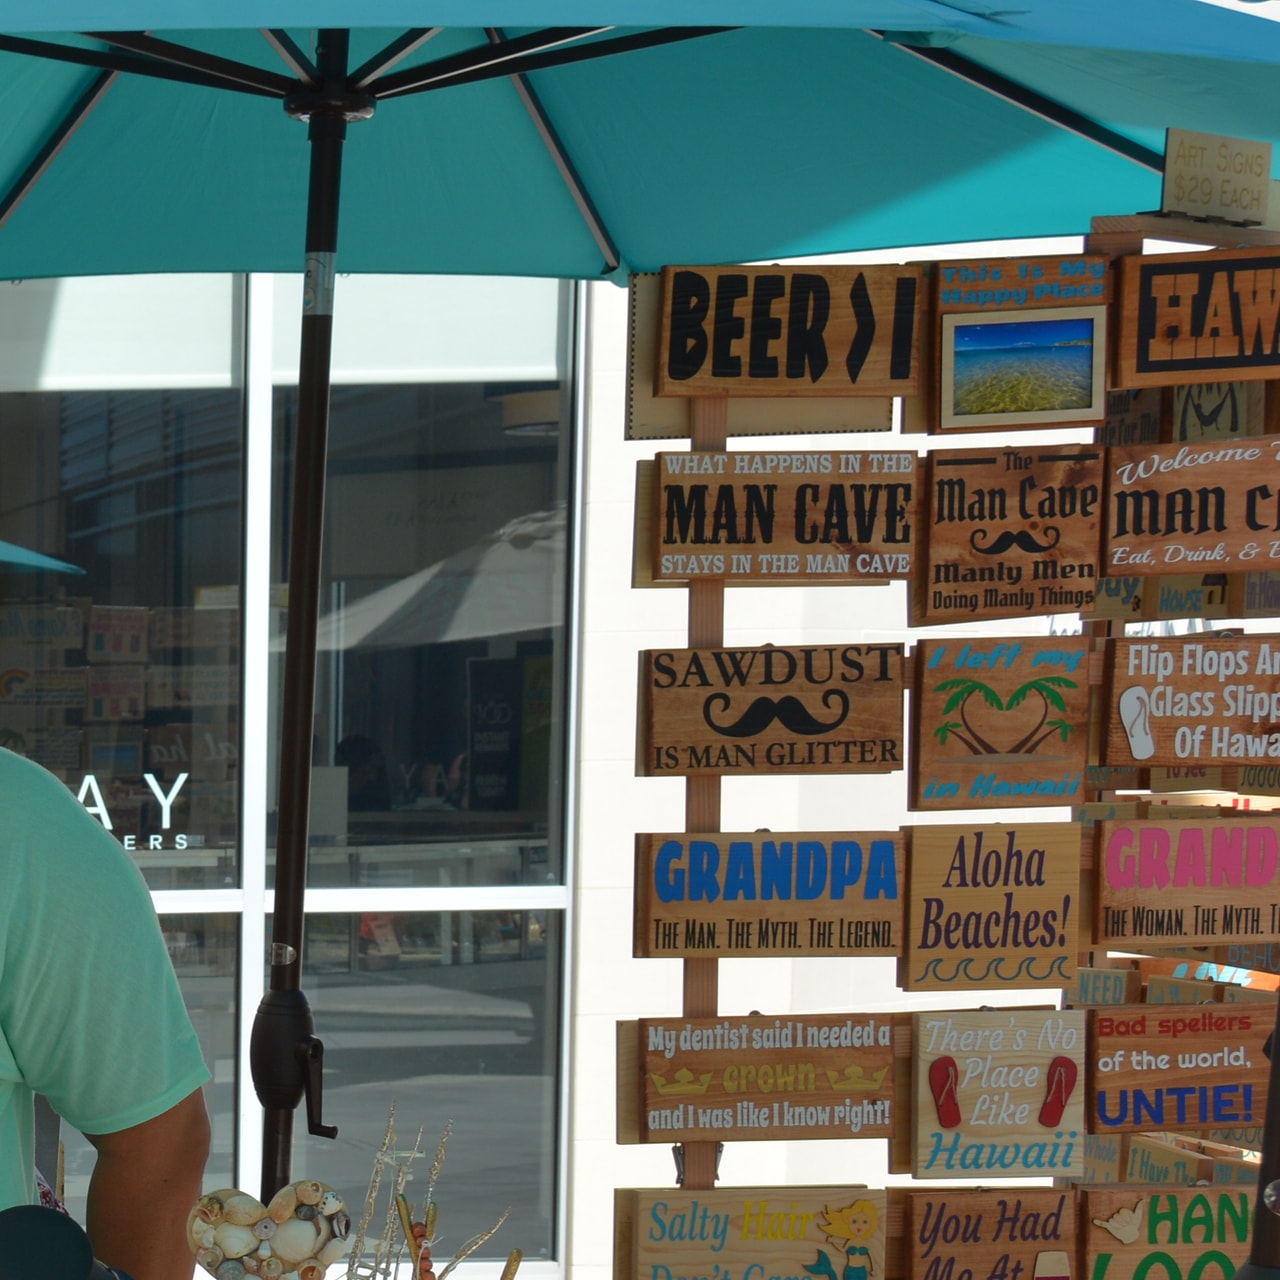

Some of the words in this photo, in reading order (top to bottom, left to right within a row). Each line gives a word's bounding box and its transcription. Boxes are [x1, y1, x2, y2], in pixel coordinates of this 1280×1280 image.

[1174, 172, 1213, 205] $29
[941, 264, 1002, 284] This
[1018, 263, 1043, 280] Is
[1059, 260, 1105, 280] My
[941, 288, 1027, 307] Happy
[1033, 282, 1104, 300] Place
[668, 271, 831, 384] BEER
[665, 455, 728, 474] WHAT
[734, 454, 833, 474] HAPPENS
[839, 454, 862, 473] IN
[868, 453, 913, 473] THE
[1003, 451, 1033, 473] The
[1116, 446, 1262, 485] Welcome
[662, 483, 778, 544] MAN
[794, 482, 912, 544] CAVE
[934, 477, 1007, 524] Man
[1019, 475, 1098, 521] Cave
[661, 554, 725, 575] STAYS
[730, 554, 752, 573] IN
[758, 554, 800, 573] THE
[806, 554, 850, 573] MAN
[856, 554, 911, 573] CAVE
[1112, 547, 1156, 566] Eat,
[1164, 542, 1230, 563] Drink,
[1238, 542, 1261, 560] &
[933, 561, 1023, 585] Manly
[1031, 559, 1095, 581] Men
[933, 590, 979, 612] Doing
[983, 588, 1035, 611] Manly
[1039, 585, 1095, 608] Things
[653, 645, 901, 689] SAWDUST
[928, 646, 946, 669] I
[954, 643, 1022, 669] left
[1031, 650, 1085, 672] my
[1128, 644, 1173, 682] Flip
[1182, 644, 1249, 682] Flops
[1150, 685, 1215, 717] Glass
[654, 746, 679, 769] IS
[687, 744, 757, 768] MAN
[765, 739, 902, 766] GLITTER
[1174, 725, 1207, 758] Of
[923, 777, 960, 799] in
[968, 774, 1083, 798] Hawaii
[654, 840, 898, 904] GRANDPA
[942, 831, 1046, 888] Aloha
[917, 892, 1071, 950] Beaches!
[648, 1026, 676, 1059] My
[680, 1021, 749, 1051] dentist
[751, 1019, 793, 1049] said
[796, 1023, 803, 1047] I
[807, 1020, 874, 1047] needed
[878, 1025, 890, 1046] a
[925, 1016, 1027, 1052] There's
[1037, 1018, 1077, 1050] No
[1099, 1016, 1146, 1037] Bad
[1158, 1012, 1252, 1038] spellers
[961, 1056, 1039, 1088] Place
[1098, 1051, 1124, 1072] of
[1130, 1051, 1170, 1070] the
[1177, 1047, 1252, 1070] world,
[722, 1062, 816, 1093] crown
[648, 1104, 684, 1130] and
[687, 1103, 694, 1128] I
[698, 1107, 733, 1129] was
[736, 1101, 769, 1127] like
[773, 1102, 779, 1126] I
[783, 1101, 831, 1126] know
[834, 1099, 890, 1132] right!
[970, 1092, 1030, 1126] Like
[1097, 1084, 1253, 1126] UNTIE!
[924, 1131, 1077, 1170] Hawaii
[648, 1201, 730, 1253] Salty
[740, 1201, 814, 1241] Hair
[920, 1202, 981, 1258] You
[992, 1195, 1065, 1242] Had
